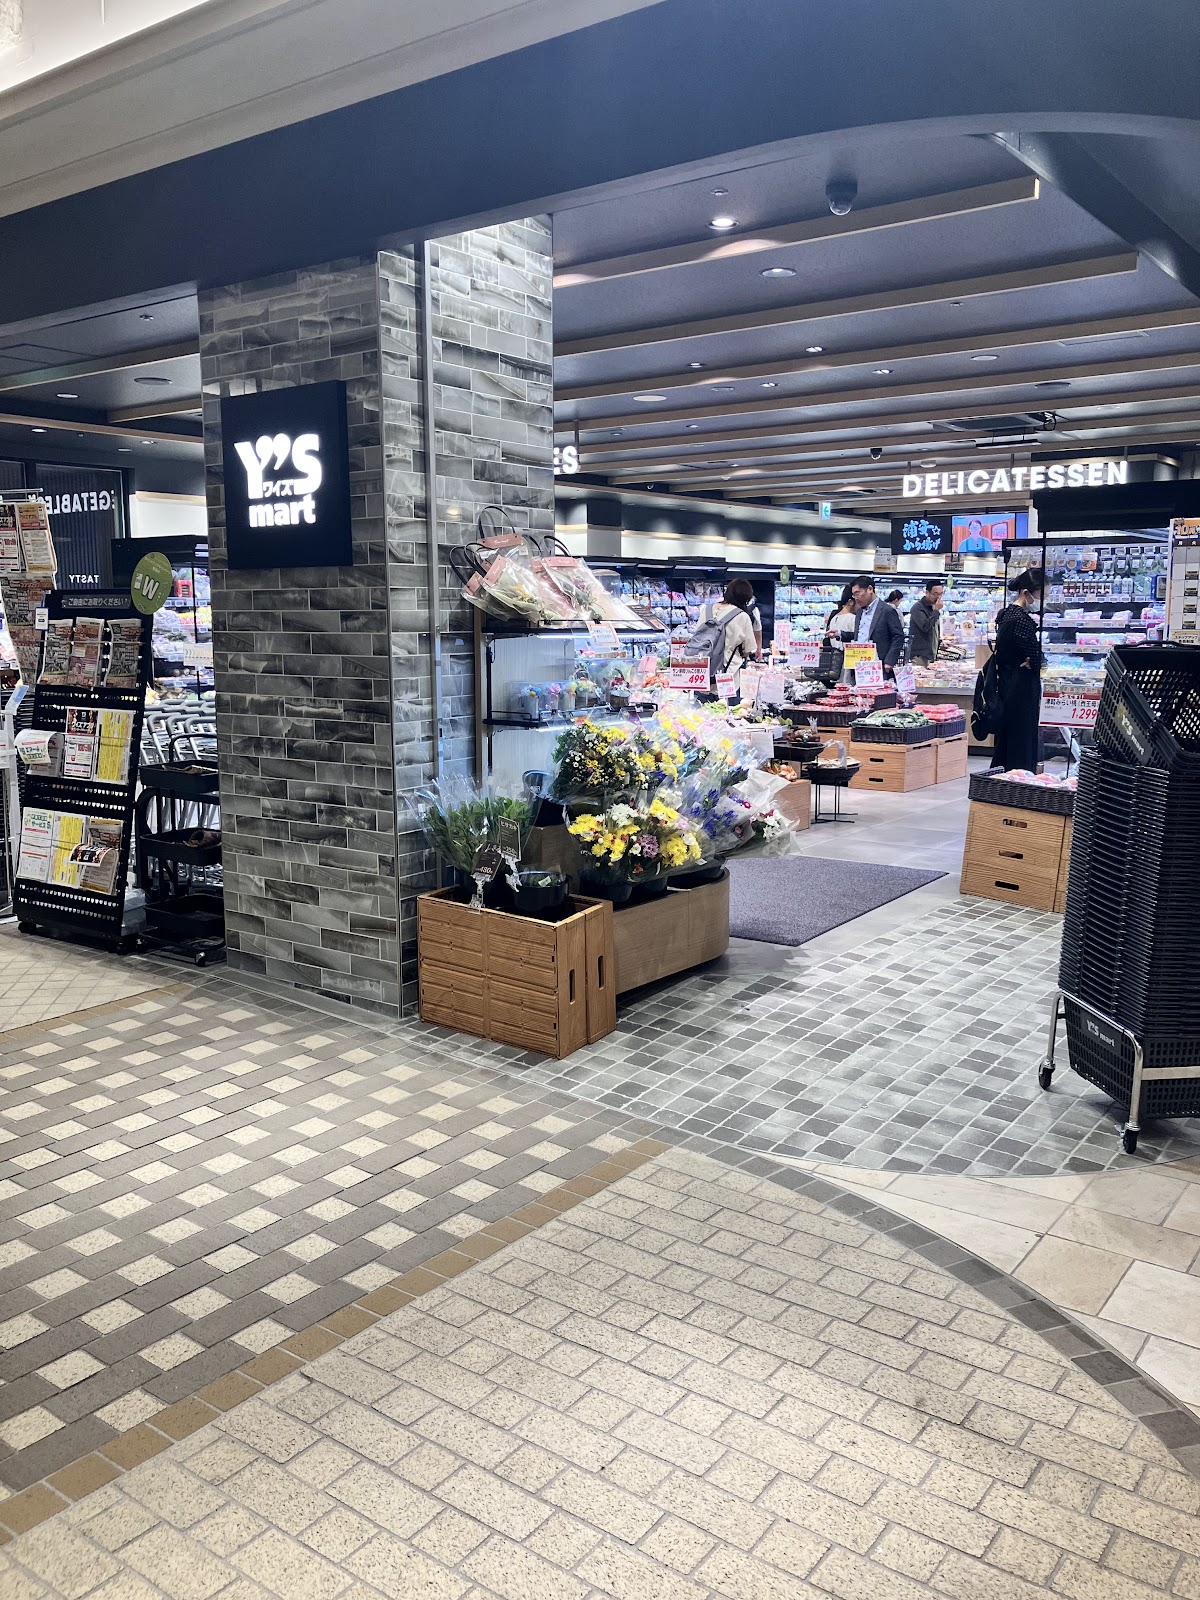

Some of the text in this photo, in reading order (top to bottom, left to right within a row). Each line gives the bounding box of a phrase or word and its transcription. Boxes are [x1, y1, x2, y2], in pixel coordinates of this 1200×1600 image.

[902, 460, 1128, 498] DELICATESSEN
[263, 480, 294, 498] ワイズ
[249, 496, 317, 528] mart
[903, 537, 941, 551] から揚げ
[1071, 707, 1098, 720] 1,299
[1099, 1032, 1115, 1047] mart
